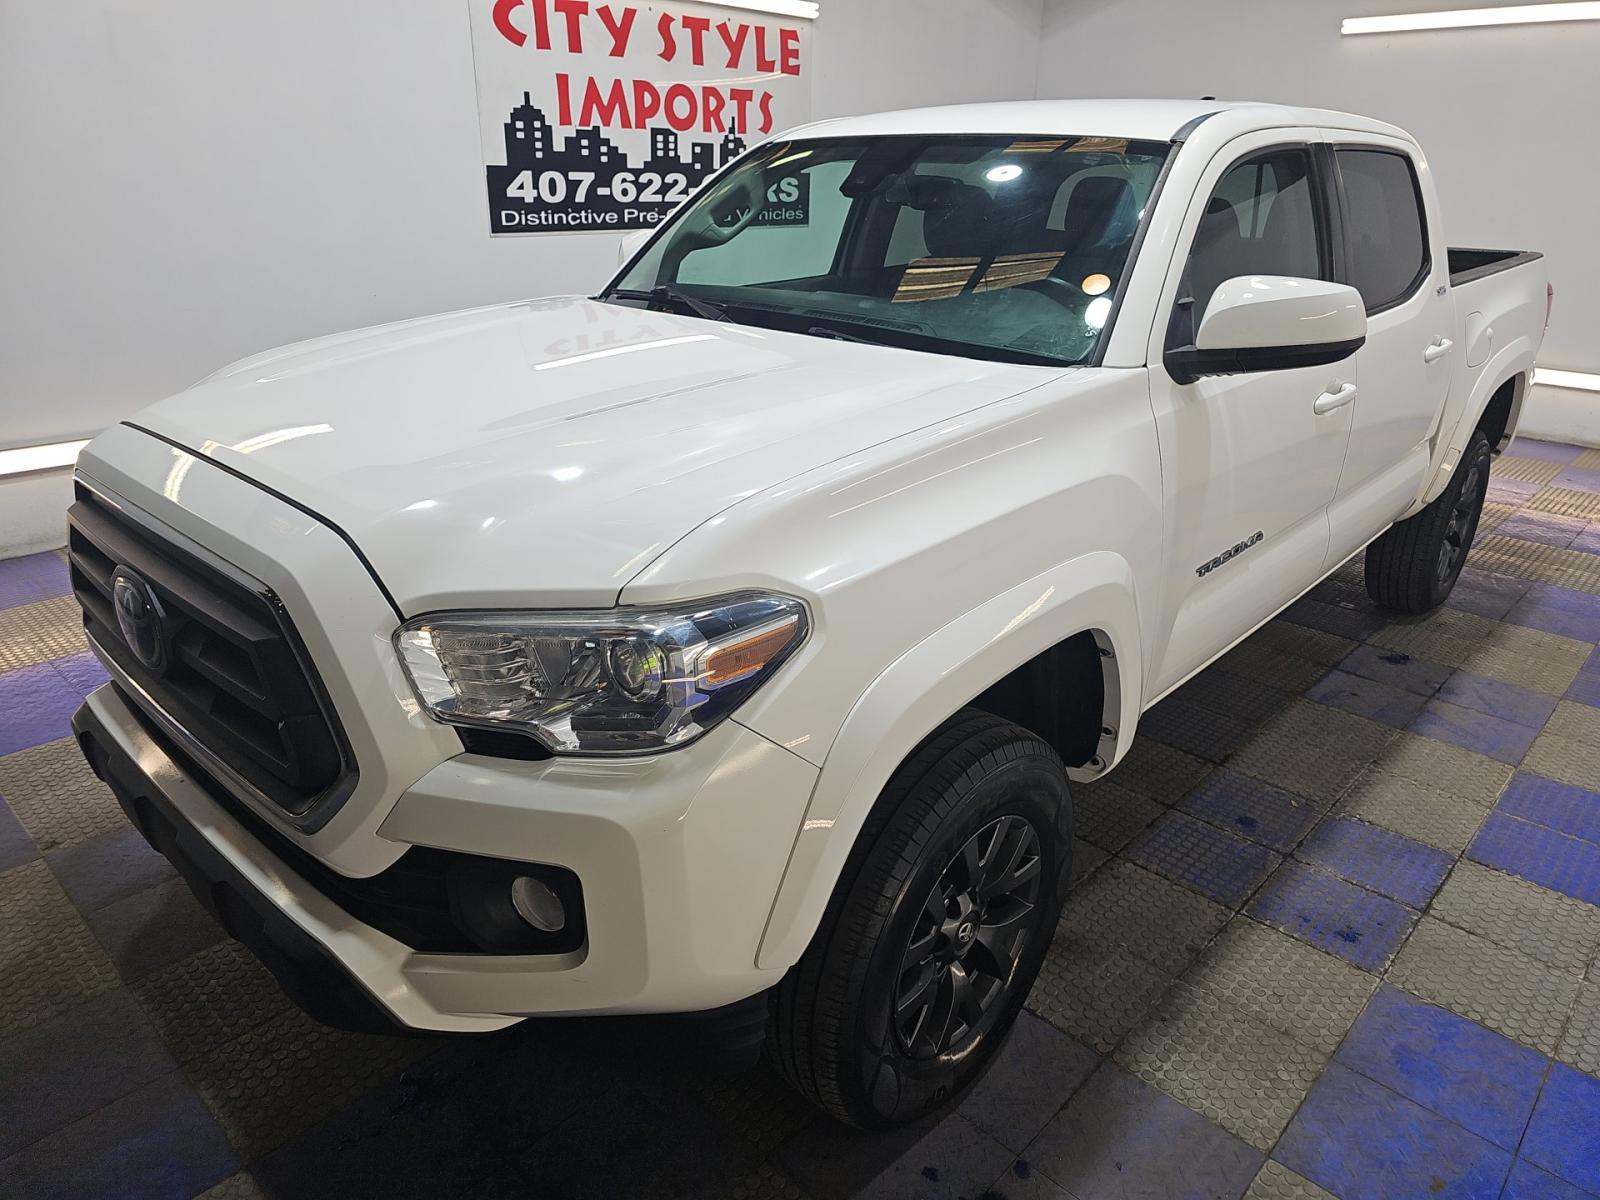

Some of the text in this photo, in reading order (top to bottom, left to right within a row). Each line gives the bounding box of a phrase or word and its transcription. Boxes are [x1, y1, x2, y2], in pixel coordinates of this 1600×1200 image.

[492, 0, 800, 76] CITY STYLE
[555, 73, 774, 134] IMPORTS
[501, 209, 618, 225] Distinctive
[1196, 530, 1264, 577] TACOMA
